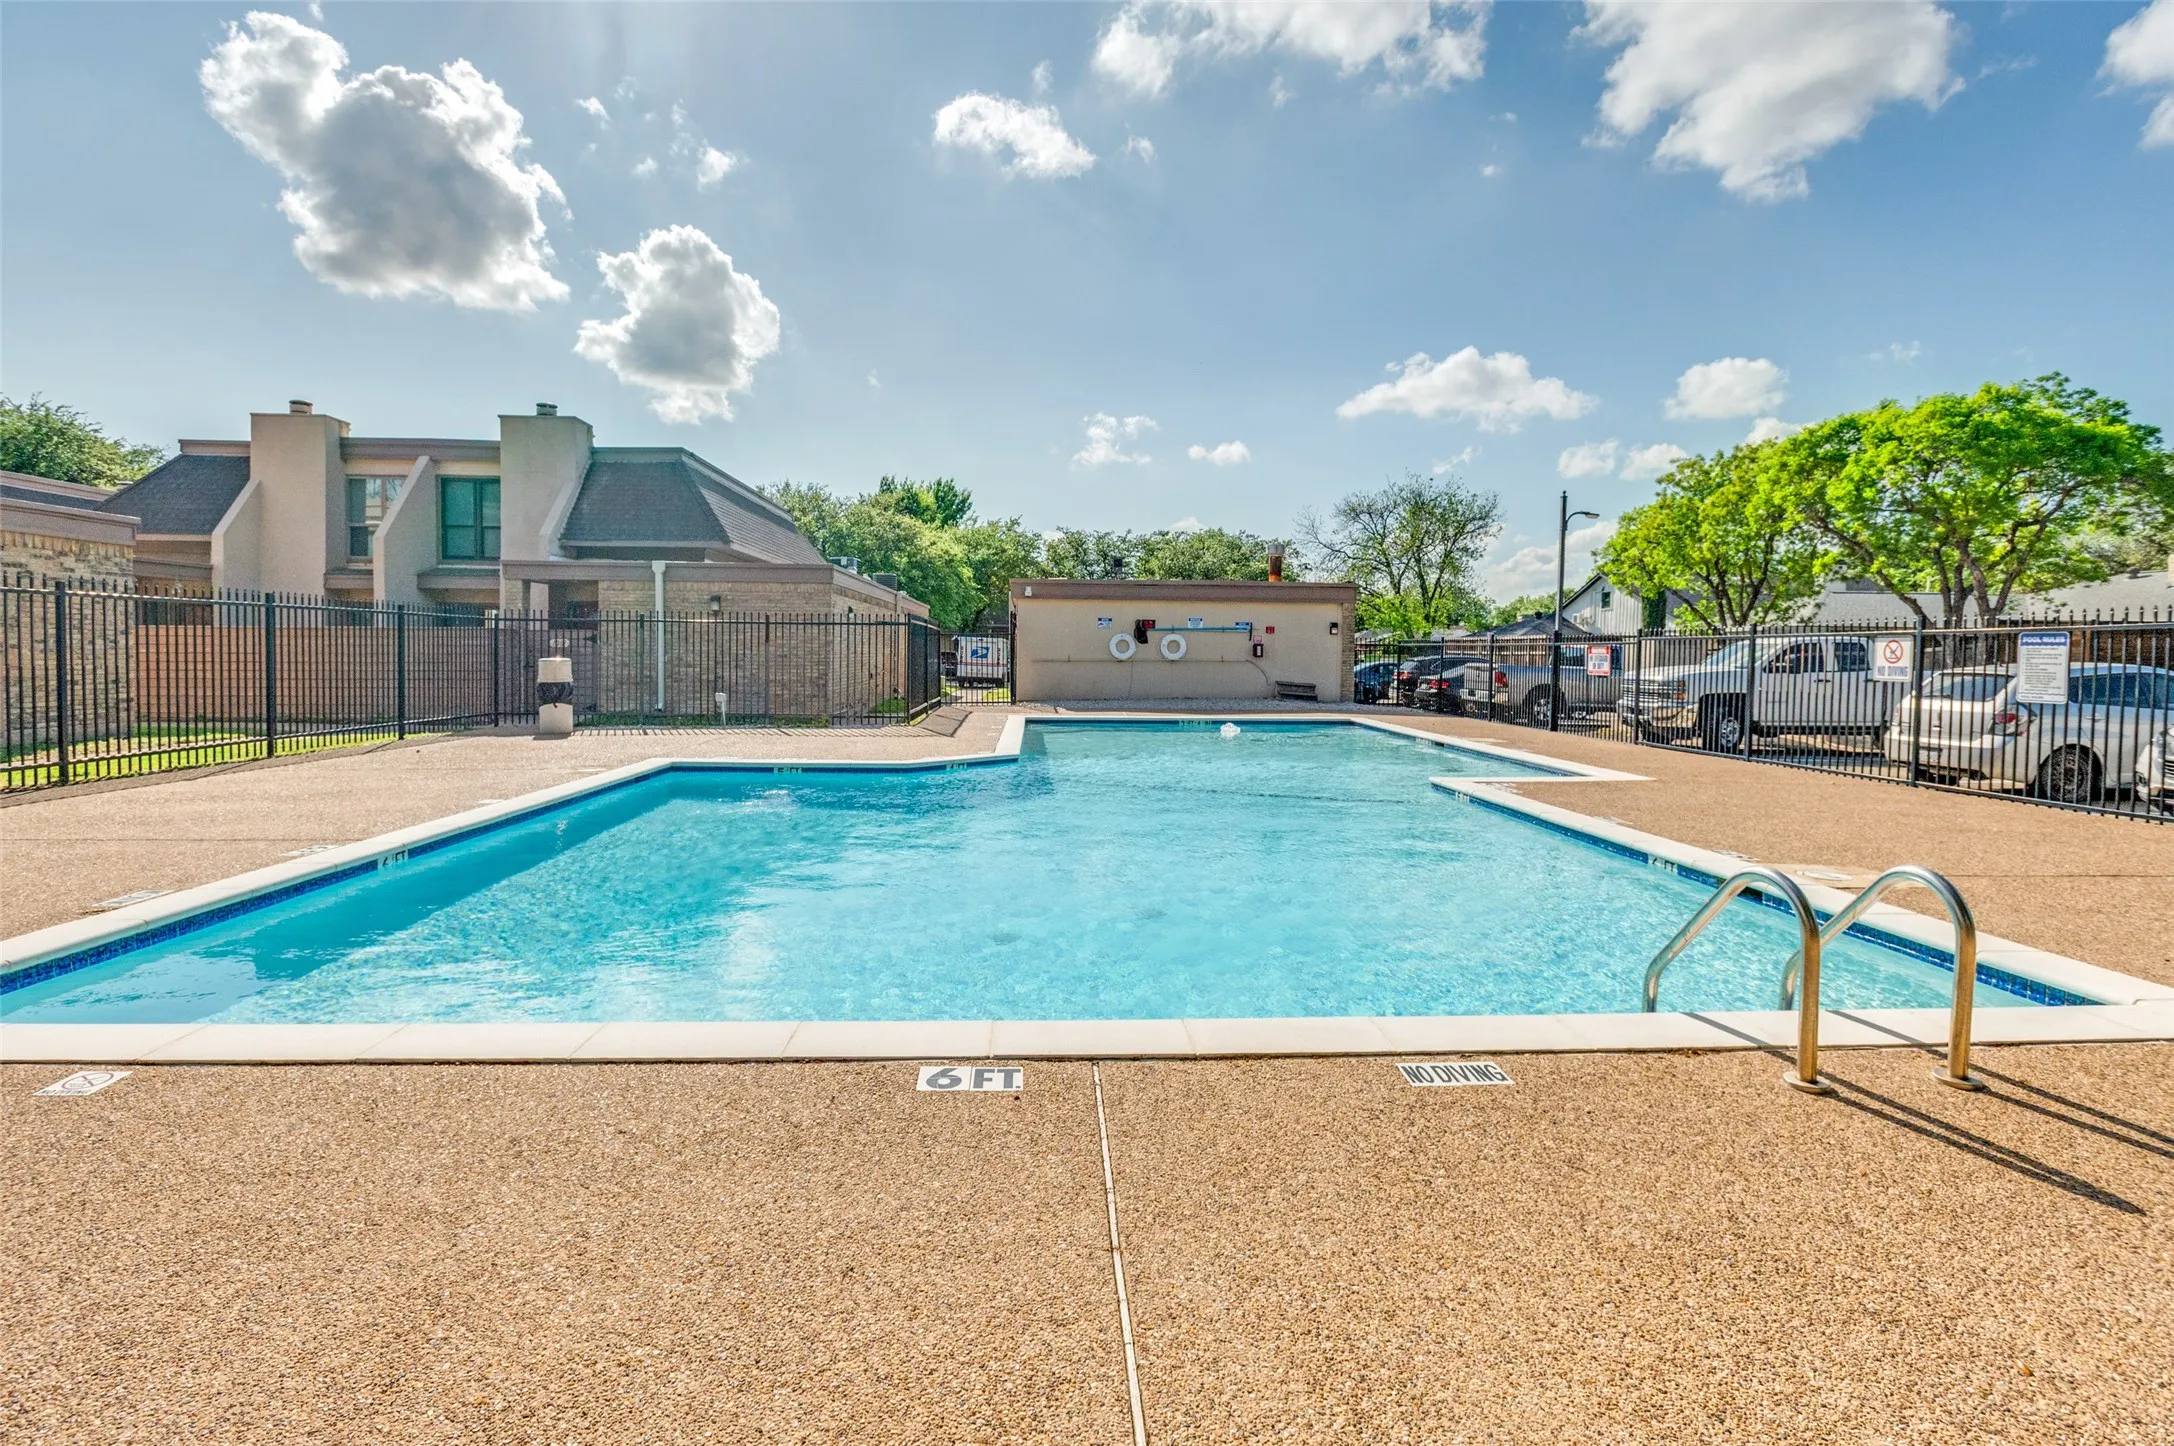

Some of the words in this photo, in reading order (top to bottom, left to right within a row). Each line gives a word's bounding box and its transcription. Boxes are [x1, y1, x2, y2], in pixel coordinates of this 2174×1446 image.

[925, 1067, 963, 1090] 6
[1400, 1065, 1435, 1083] NO
[1429, 1064, 1509, 1083] DIVING
